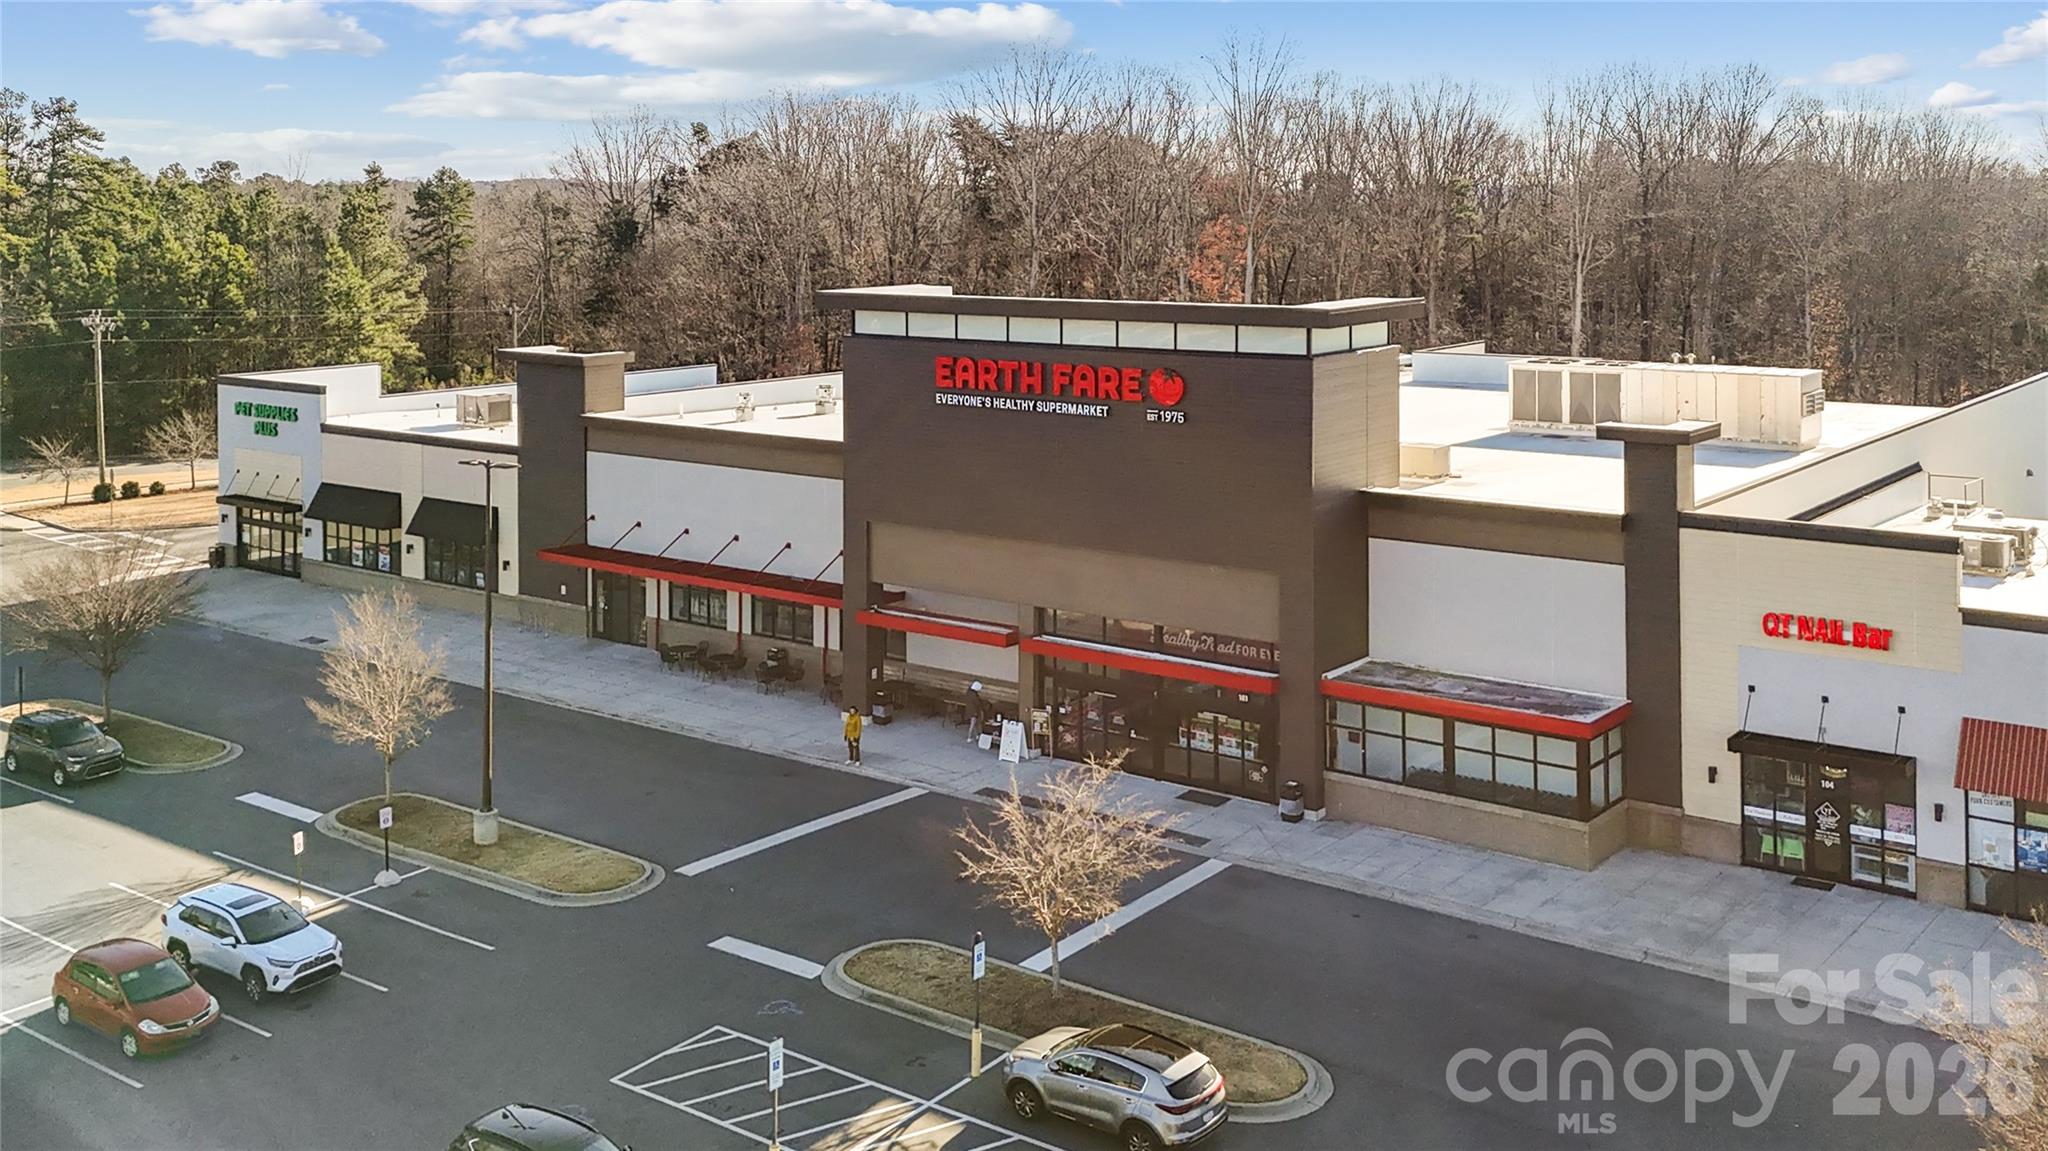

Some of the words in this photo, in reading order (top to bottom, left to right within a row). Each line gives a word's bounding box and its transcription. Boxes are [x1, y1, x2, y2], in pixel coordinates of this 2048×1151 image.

[935, 356, 1042, 395] EARTH
[1052, 363, 1143, 402] FARE
[234, 401, 252, 416] PET
[253, 403, 298, 422] SUPPLIES
[935, 392, 992, 408] EVERYONE'S
[993, 397, 1035, 412] HEALTHY
[1036, 400, 1109, 417] SUPERMARKET
[1159, 410, 1185, 423] 1975
[254, 420, 279, 437] PLUS
[1762, 612, 1793, 638] QT
[1797, 615, 1850, 646] NAIL
[1852, 622, 1893, 651] Bar
[1820, 780, 1835, 790] 104
